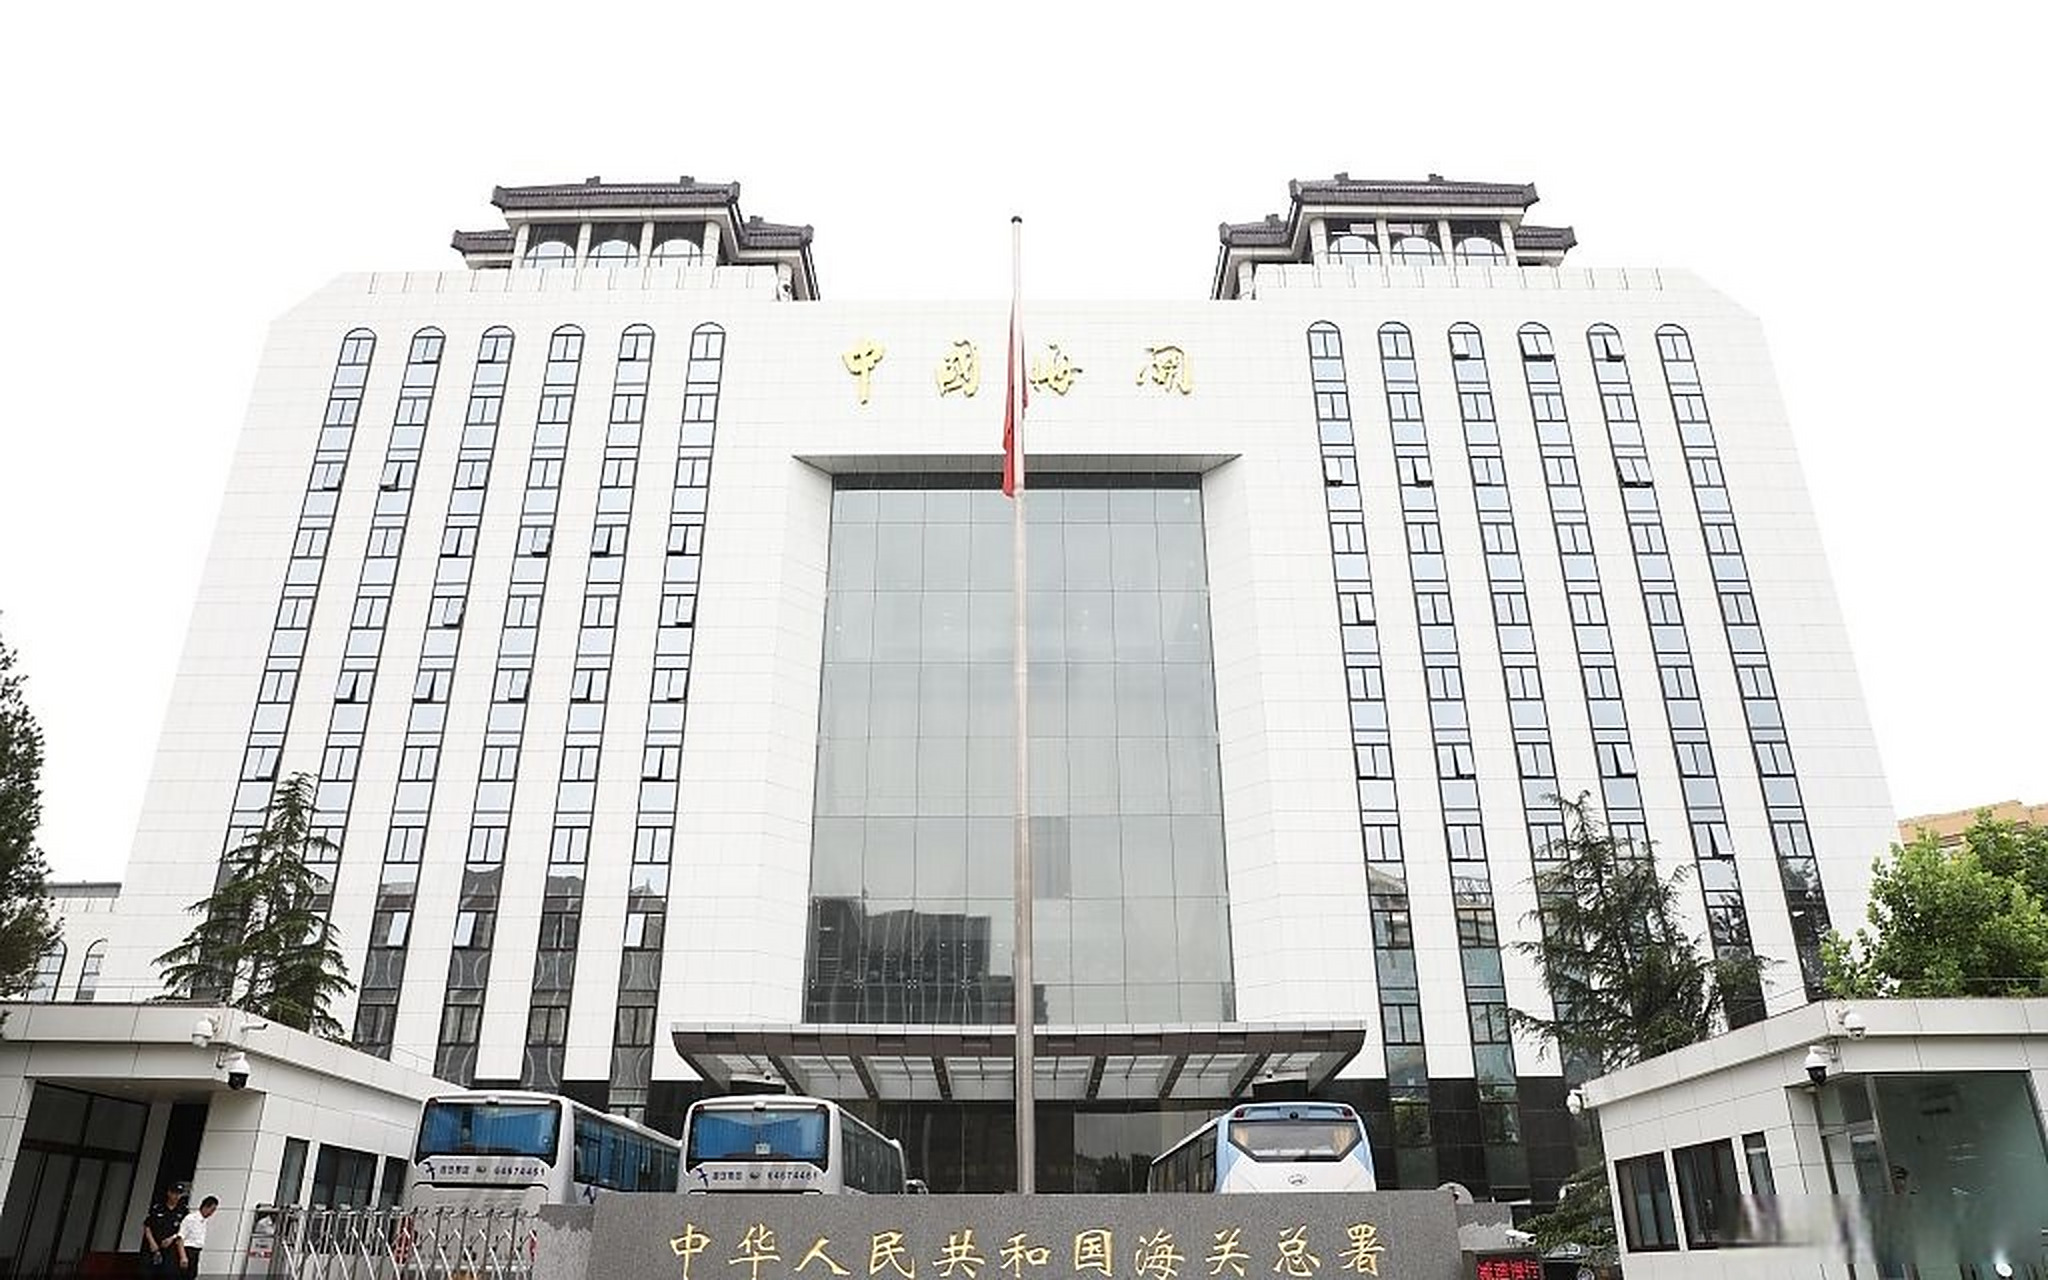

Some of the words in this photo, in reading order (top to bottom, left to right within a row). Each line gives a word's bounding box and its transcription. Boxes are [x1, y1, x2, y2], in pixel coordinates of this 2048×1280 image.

[669, 1222, 1386, 1280] 中华人民共和国海关总署
